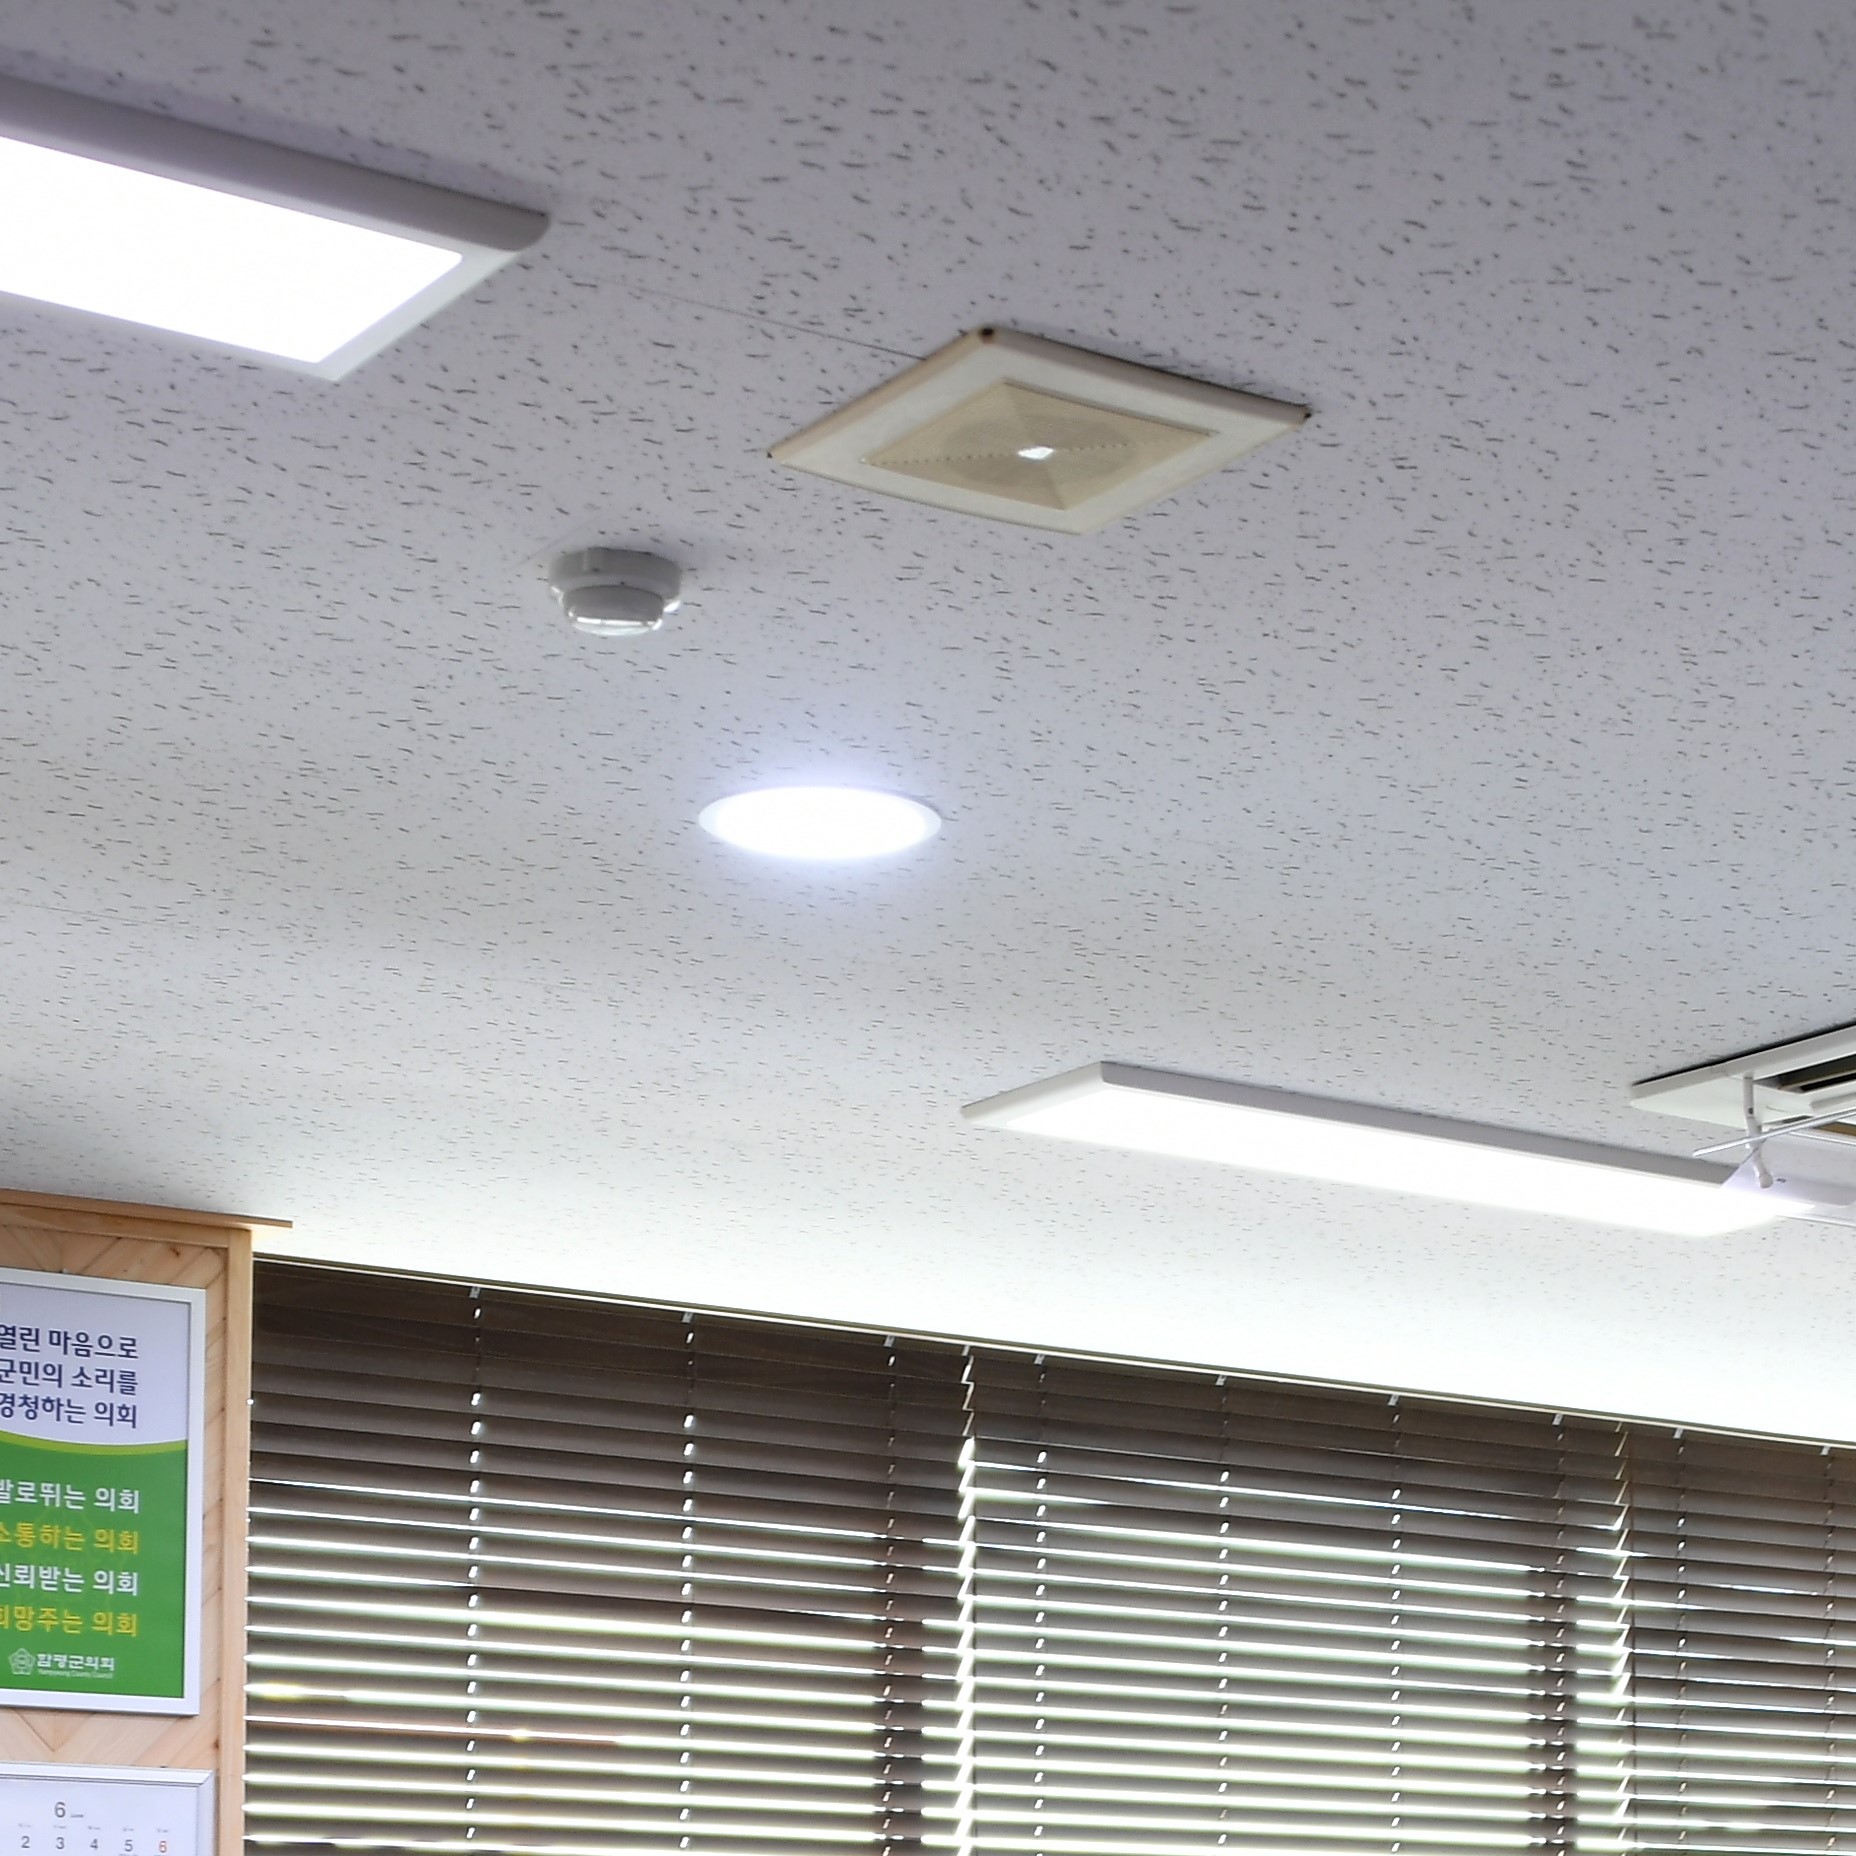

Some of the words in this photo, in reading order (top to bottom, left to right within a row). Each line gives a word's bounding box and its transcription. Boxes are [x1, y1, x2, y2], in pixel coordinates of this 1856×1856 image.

[49, 1328, 139, 1360] 마음으로
[71, 1366, 139, 1395] 소리를
[93, 1401, 138, 1428] 의회
[94, 1486, 140, 1514] 의회
[94, 1528, 139, 1554] 의회
[93, 1569, 139, 1596] 의회
[92, 1611, 138, 1636] 의회
[37, 1653, 115, 1671] 함평군의회
[55, 1802, 65, 1818] 6
[21, 1836, 30, 1848] 2
[56, 1837, 64, 1849] 3
[90, 1839, 98, 1849] 4
[125, 1840, 133, 1852] 5
[159, 1841, 167, 1853] 6
